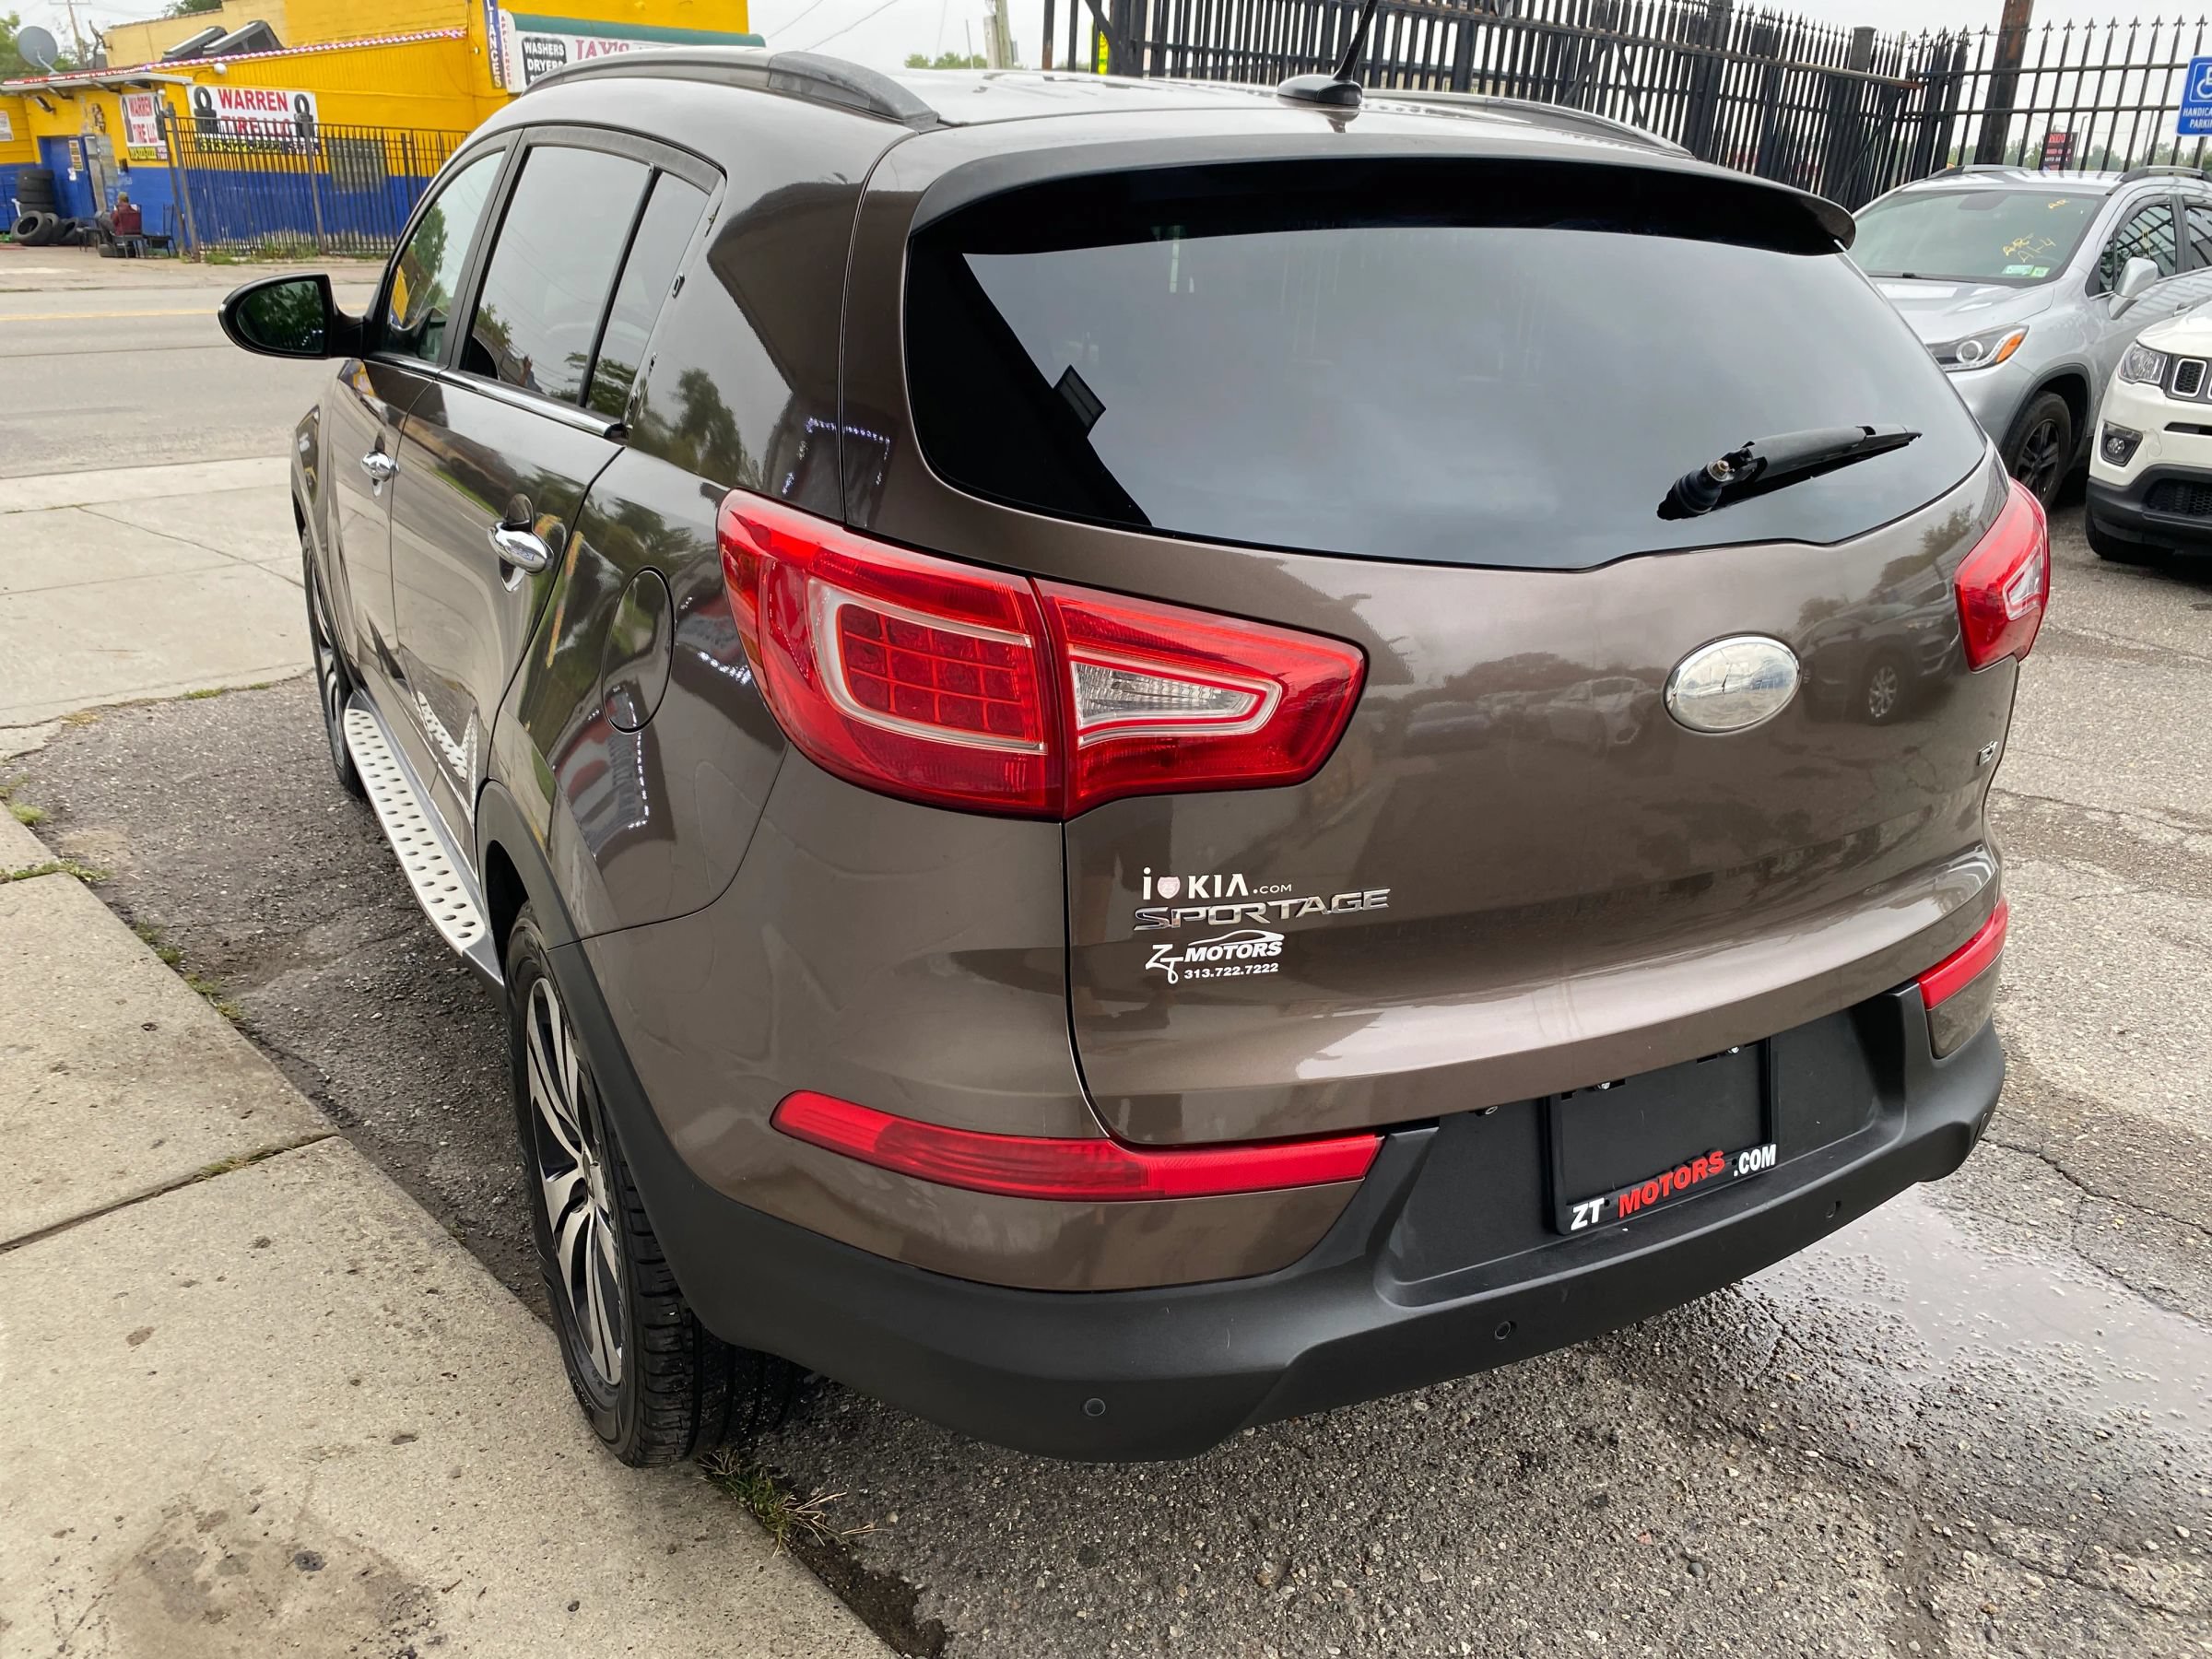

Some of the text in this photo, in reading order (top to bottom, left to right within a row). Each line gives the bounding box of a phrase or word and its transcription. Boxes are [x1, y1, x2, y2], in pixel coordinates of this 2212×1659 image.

[524, 41, 565, 56] WASHERS
[217, 88, 289, 112] WARREN
[1134, 888, 1391, 931] SPORTAGE
[1183, 940, 1284, 963] MOTORS
[1183, 962, 1279, 980] 313.722.7222
[1570, 1144, 1777, 1231] ZT MOTORS .COM
